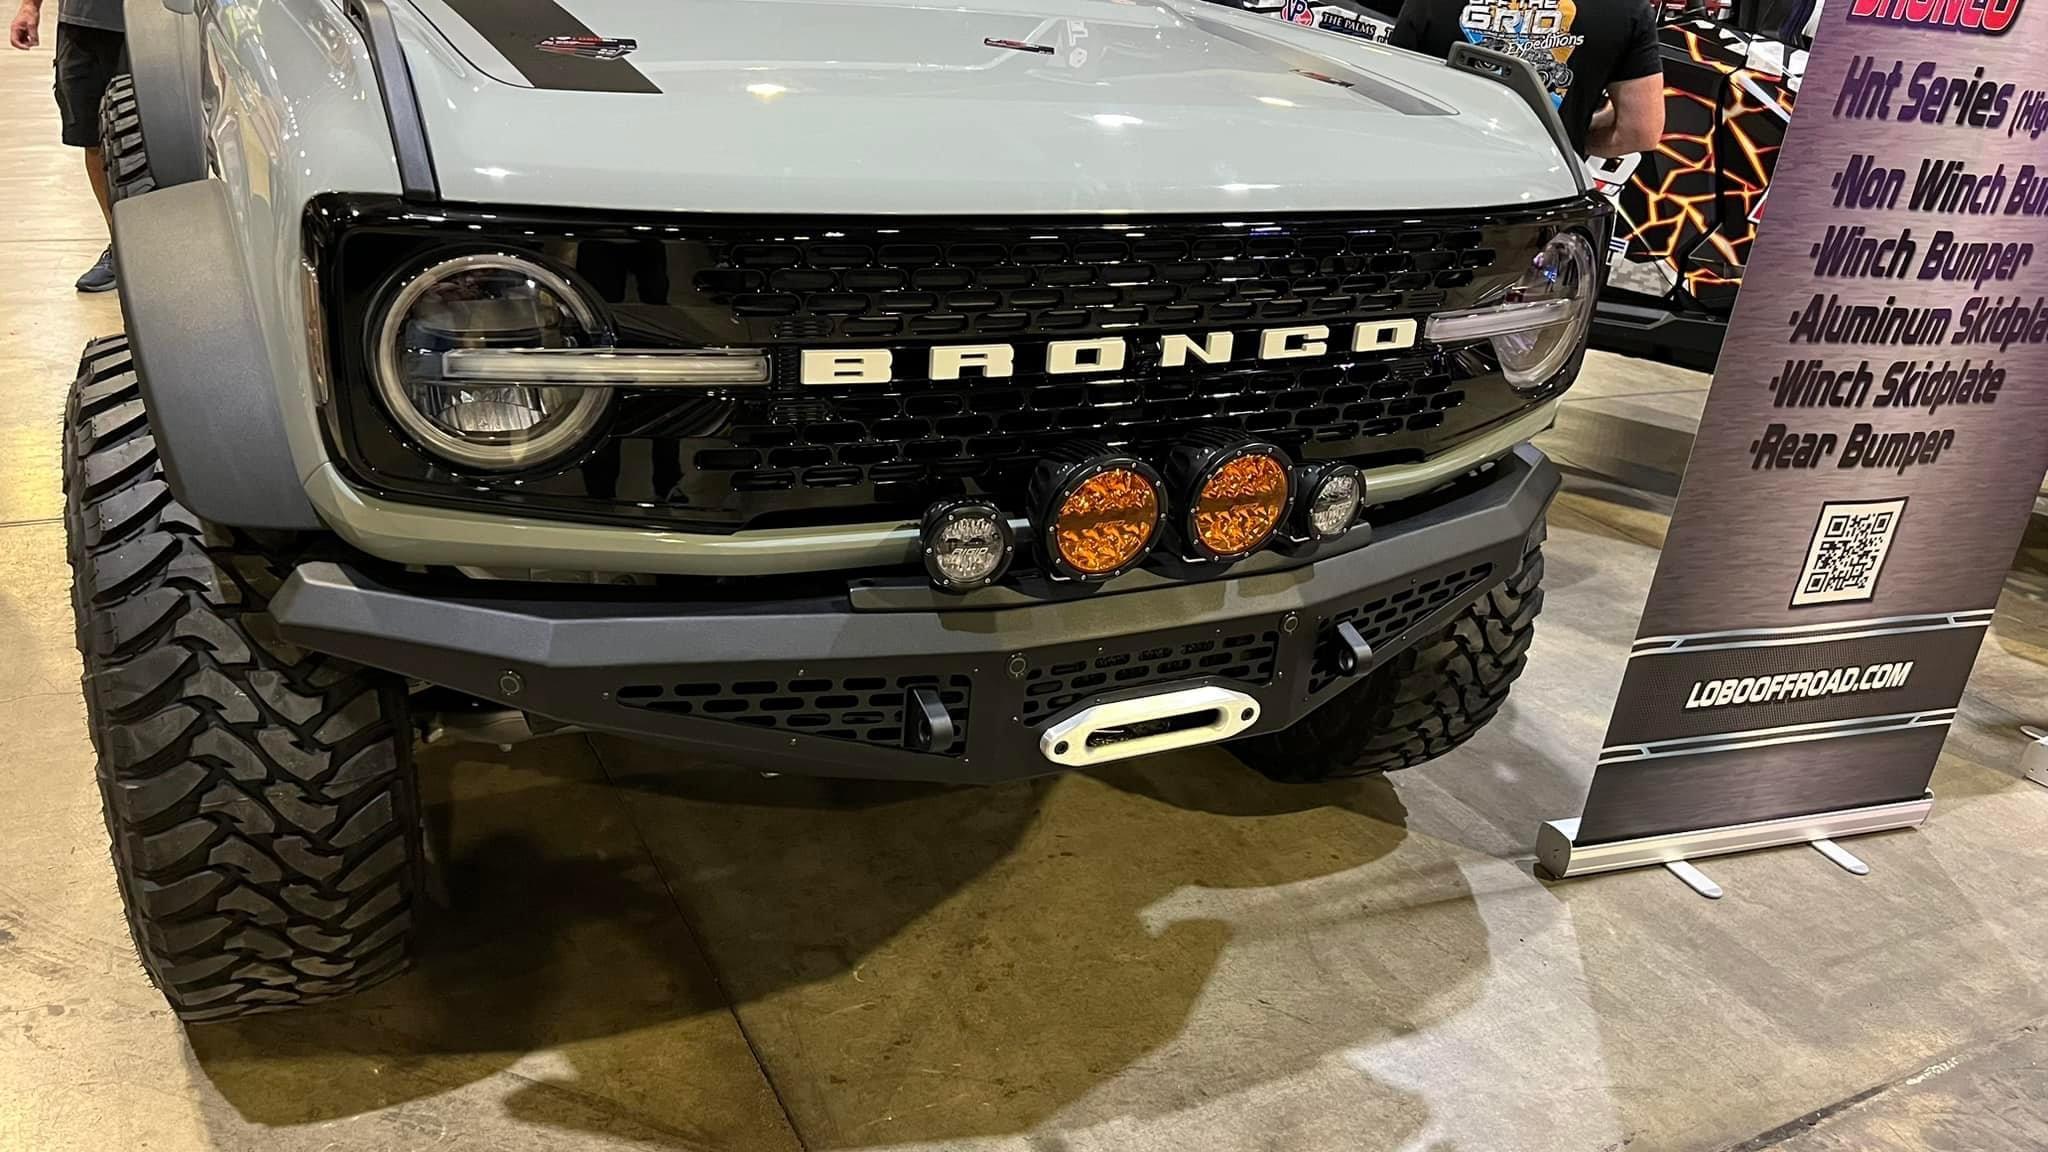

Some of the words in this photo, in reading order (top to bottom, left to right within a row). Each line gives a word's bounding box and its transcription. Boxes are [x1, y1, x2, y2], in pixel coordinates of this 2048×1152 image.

[1322, 13, 1343, 26] THE
[1344, 18, 1376, 36] PALMS
[1461, 5, 1563, 34] GRID
[1507, 32, 1585, 57] Expeditions
[1833, 56, 1903, 120] Hnt
[1898, 62, 2015, 128] Series
[1908, 159, 2006, 214] Winch
[1814, 226, 1916, 279] Winch
[1918, 231, 2034, 289] Bumper
[1789, 294, 1952, 344] Aluminum
[1951, 295, 2048, 352] Skidpla
[800, 318, 1418, 384] BRONCO
[1773, 360, 1873, 408] Winch
[1873, 360, 2006, 415] Skidplate
[1752, 424, 1837, 470] Rear
[1837, 424, 1955, 475] Bumper
[1685, 661, 1914, 709] LOBOOFFROAD.COM
